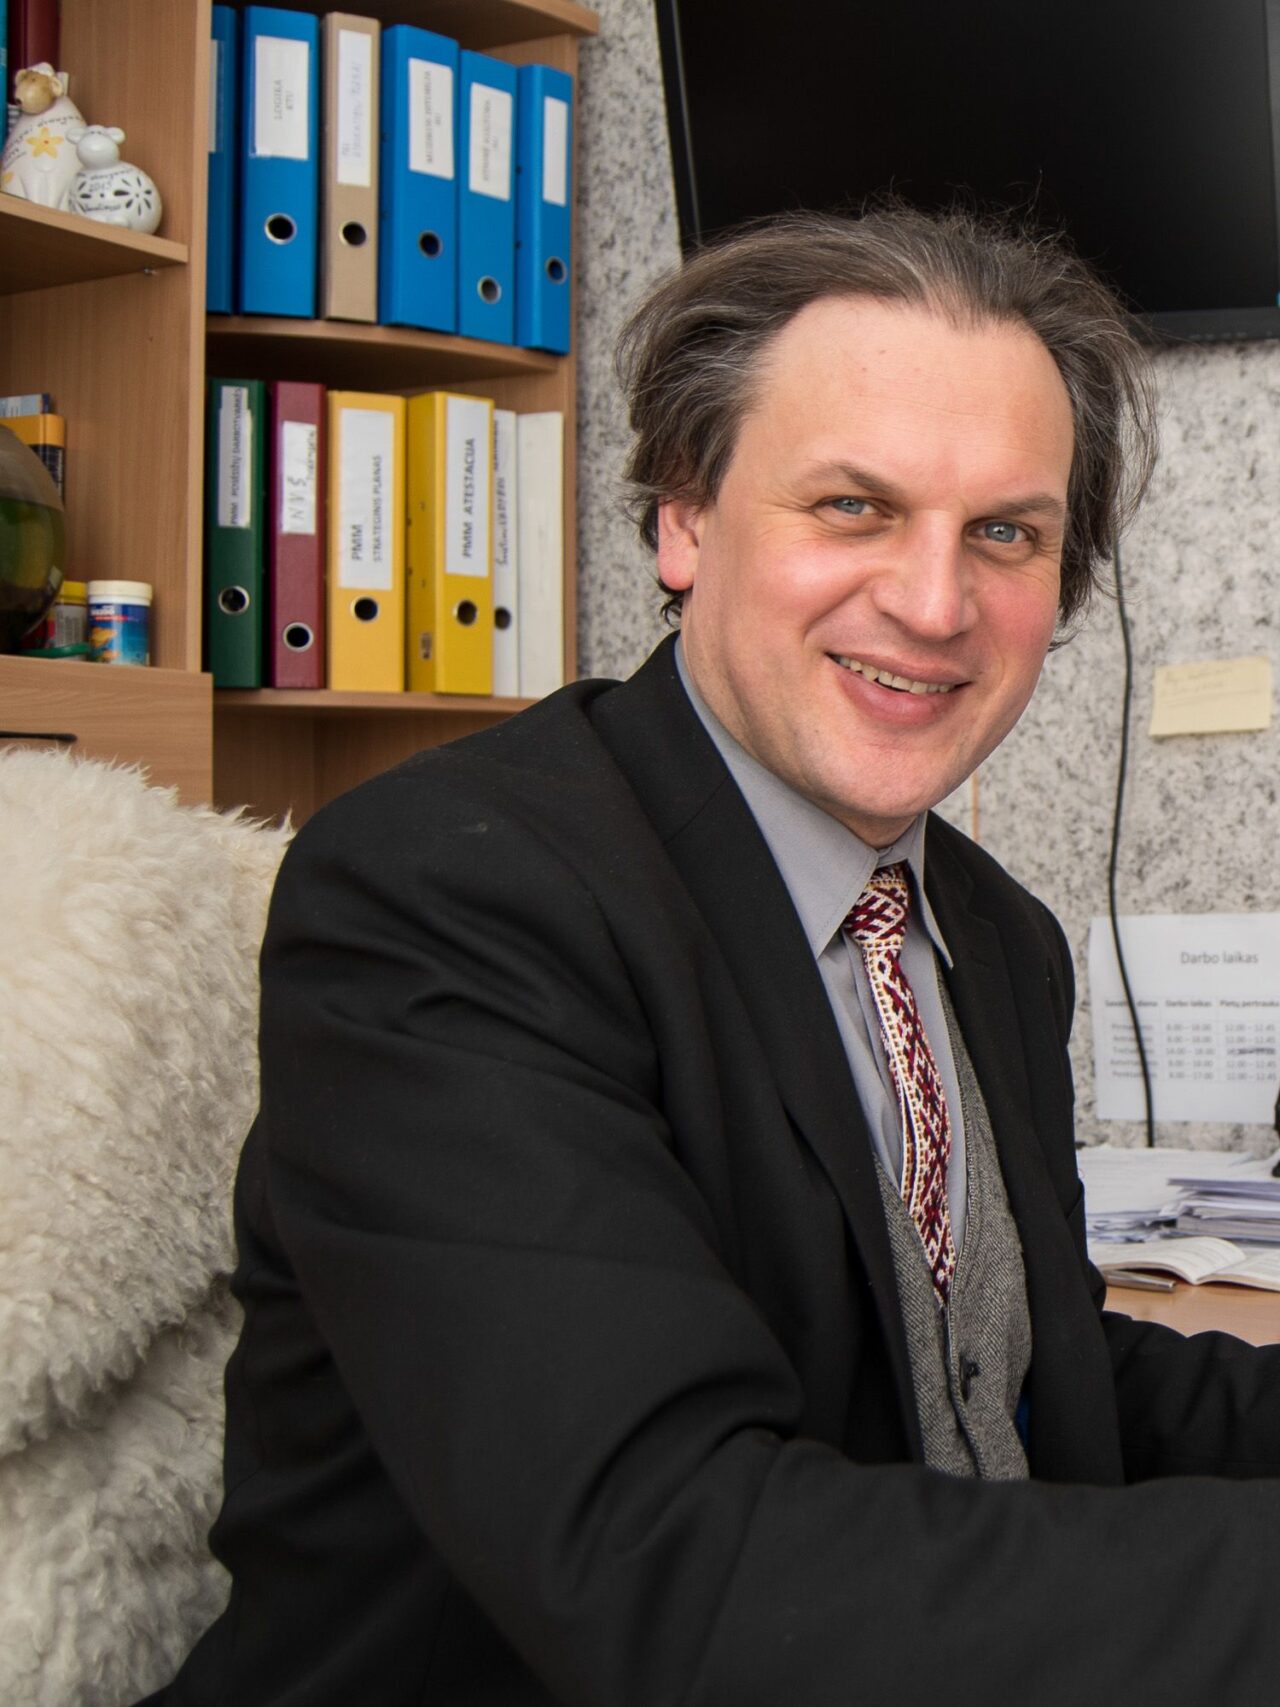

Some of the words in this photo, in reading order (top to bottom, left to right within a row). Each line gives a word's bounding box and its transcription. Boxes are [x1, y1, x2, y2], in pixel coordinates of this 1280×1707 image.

[372, 455, 382, 495] PLANAS
[462, 438, 475, 515] ATESTACIJA
[351, 523, 363, 561] PMM
[372, 497, 382, 563] STRATEGINIS
[462, 521, 473, 559] PMM
[1180, 951, 1219, 965] Darbo
[1223, 951, 1259, 964] laikas
